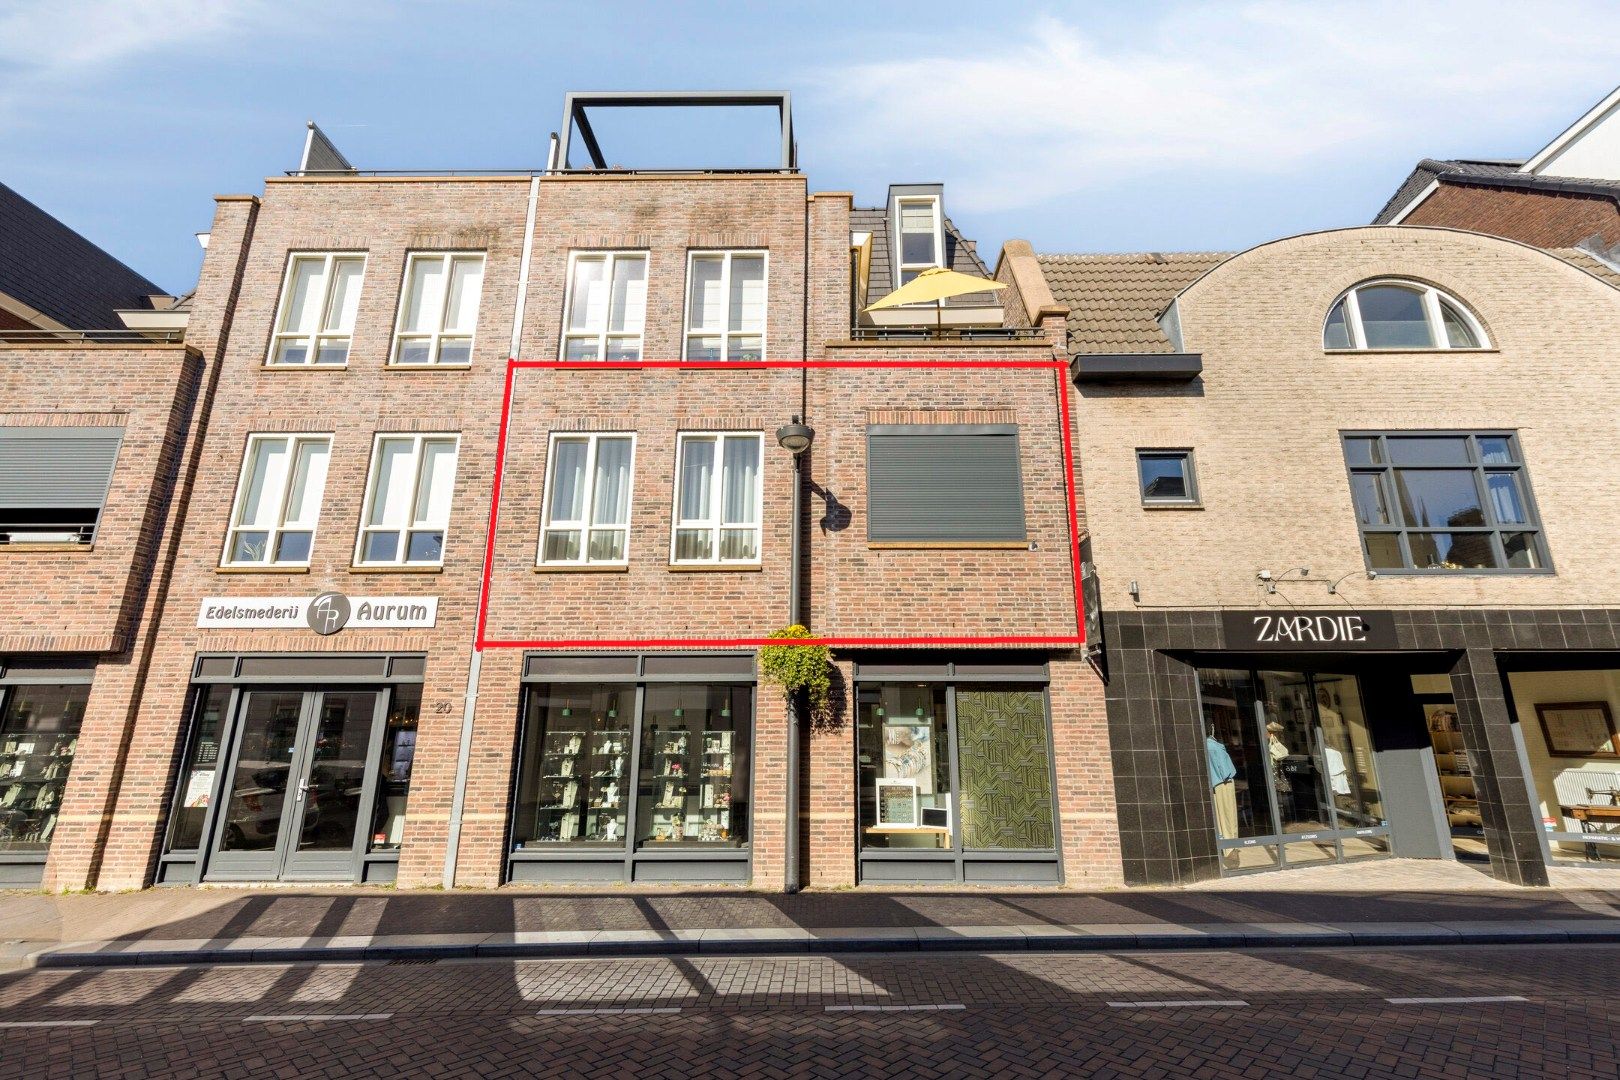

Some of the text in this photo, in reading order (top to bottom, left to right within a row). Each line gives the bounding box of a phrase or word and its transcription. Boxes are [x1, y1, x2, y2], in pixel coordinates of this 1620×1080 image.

[205, 606, 299, 620] Edelsmederij
[356, 601, 428, 621] Aurum
[1253, 616, 1366, 641] ZARDIE
[435, 702, 452, 714] 20
